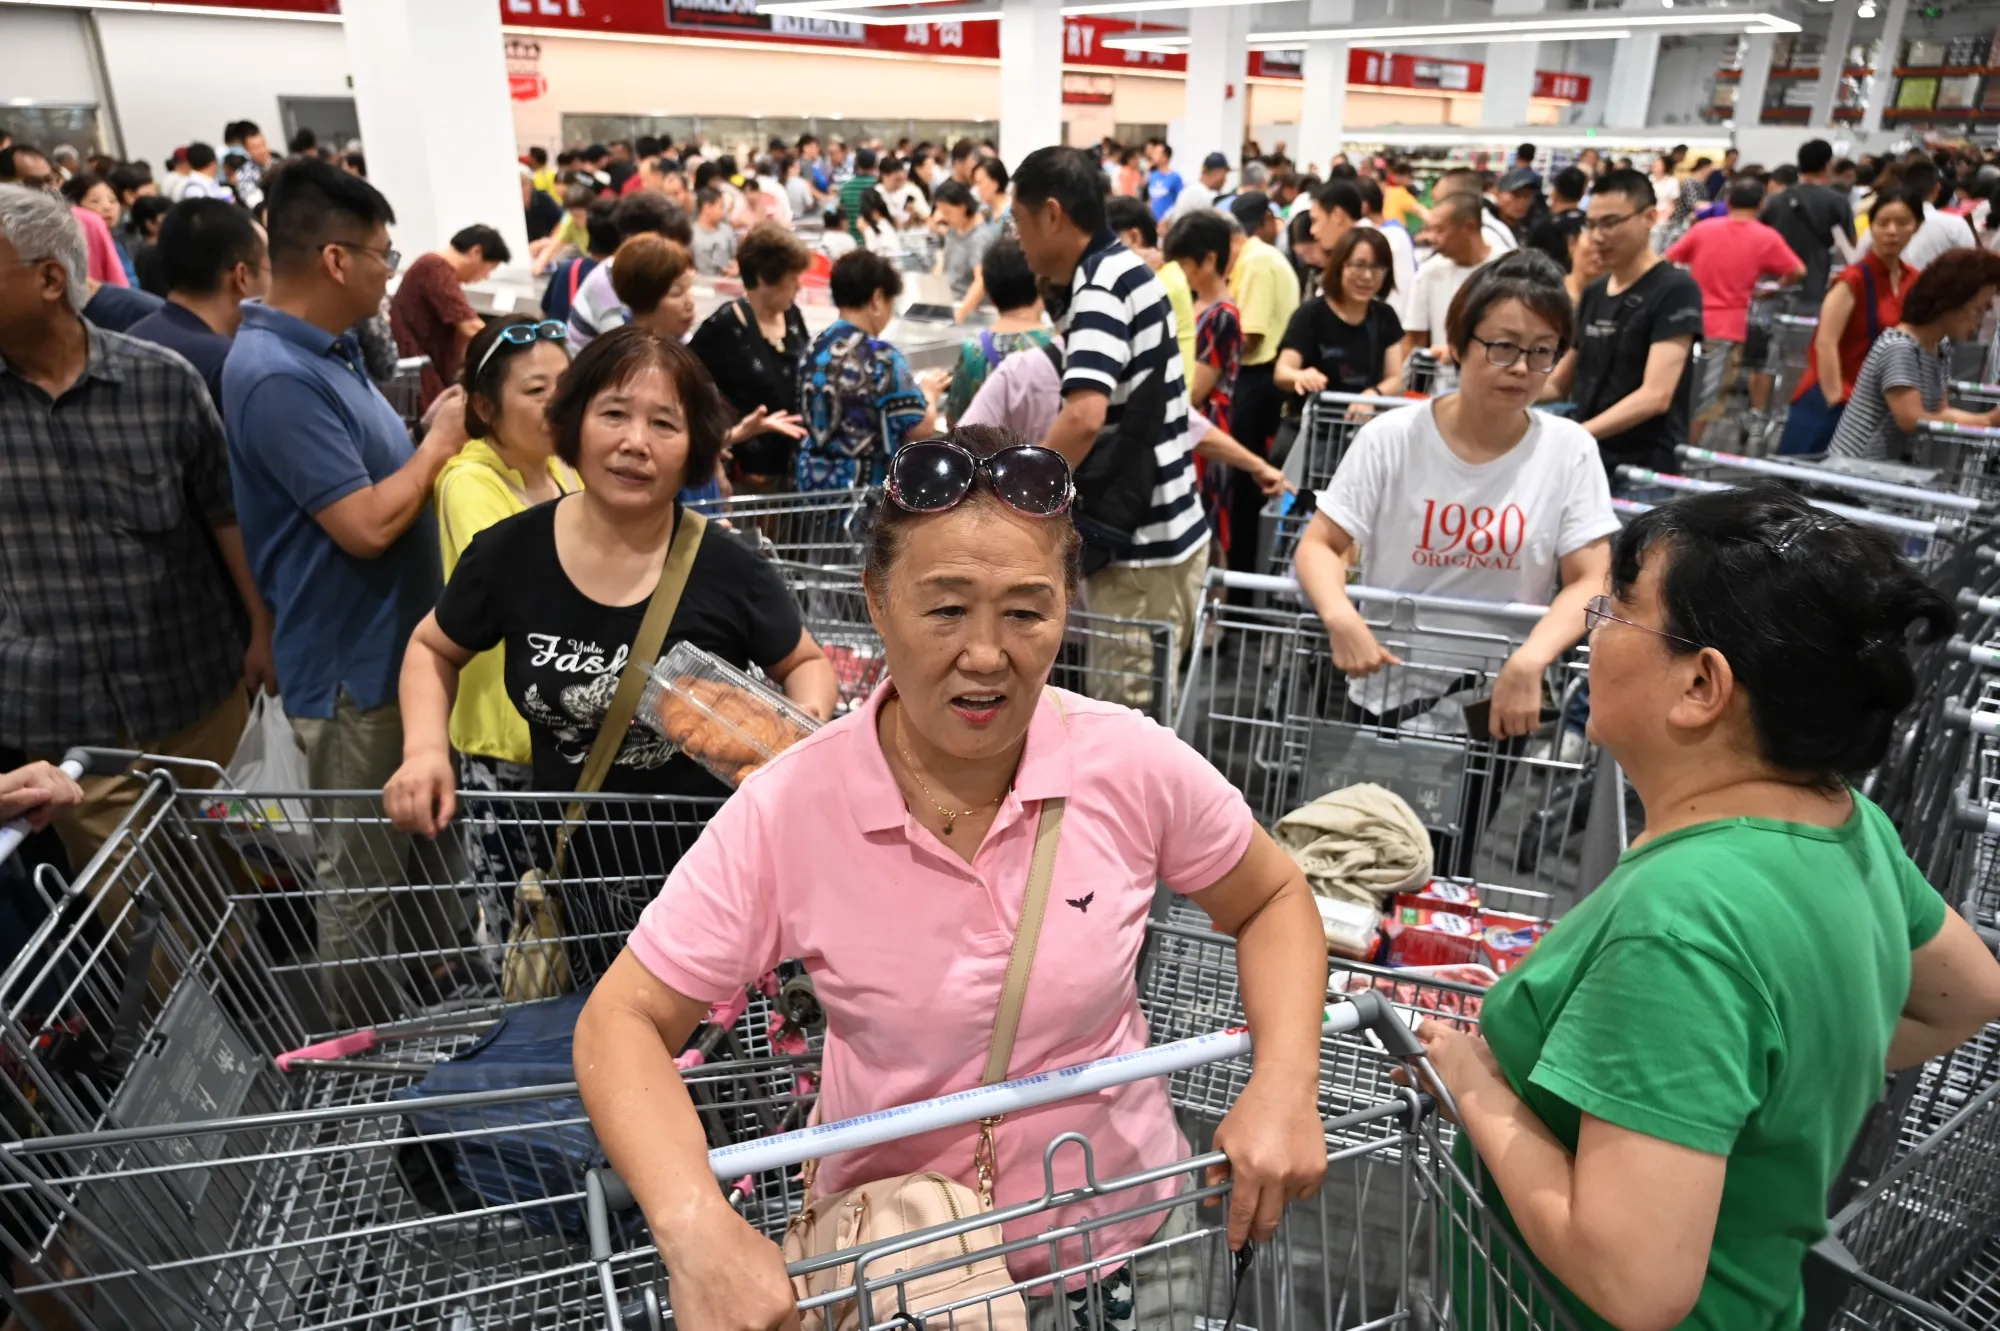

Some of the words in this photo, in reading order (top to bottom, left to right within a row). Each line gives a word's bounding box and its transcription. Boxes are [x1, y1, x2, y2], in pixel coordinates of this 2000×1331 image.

[1415, 498, 1525, 557] 1980
[1412, 551, 1522, 570] ORIGINAL
[567, 639, 605, 655] Yulu
